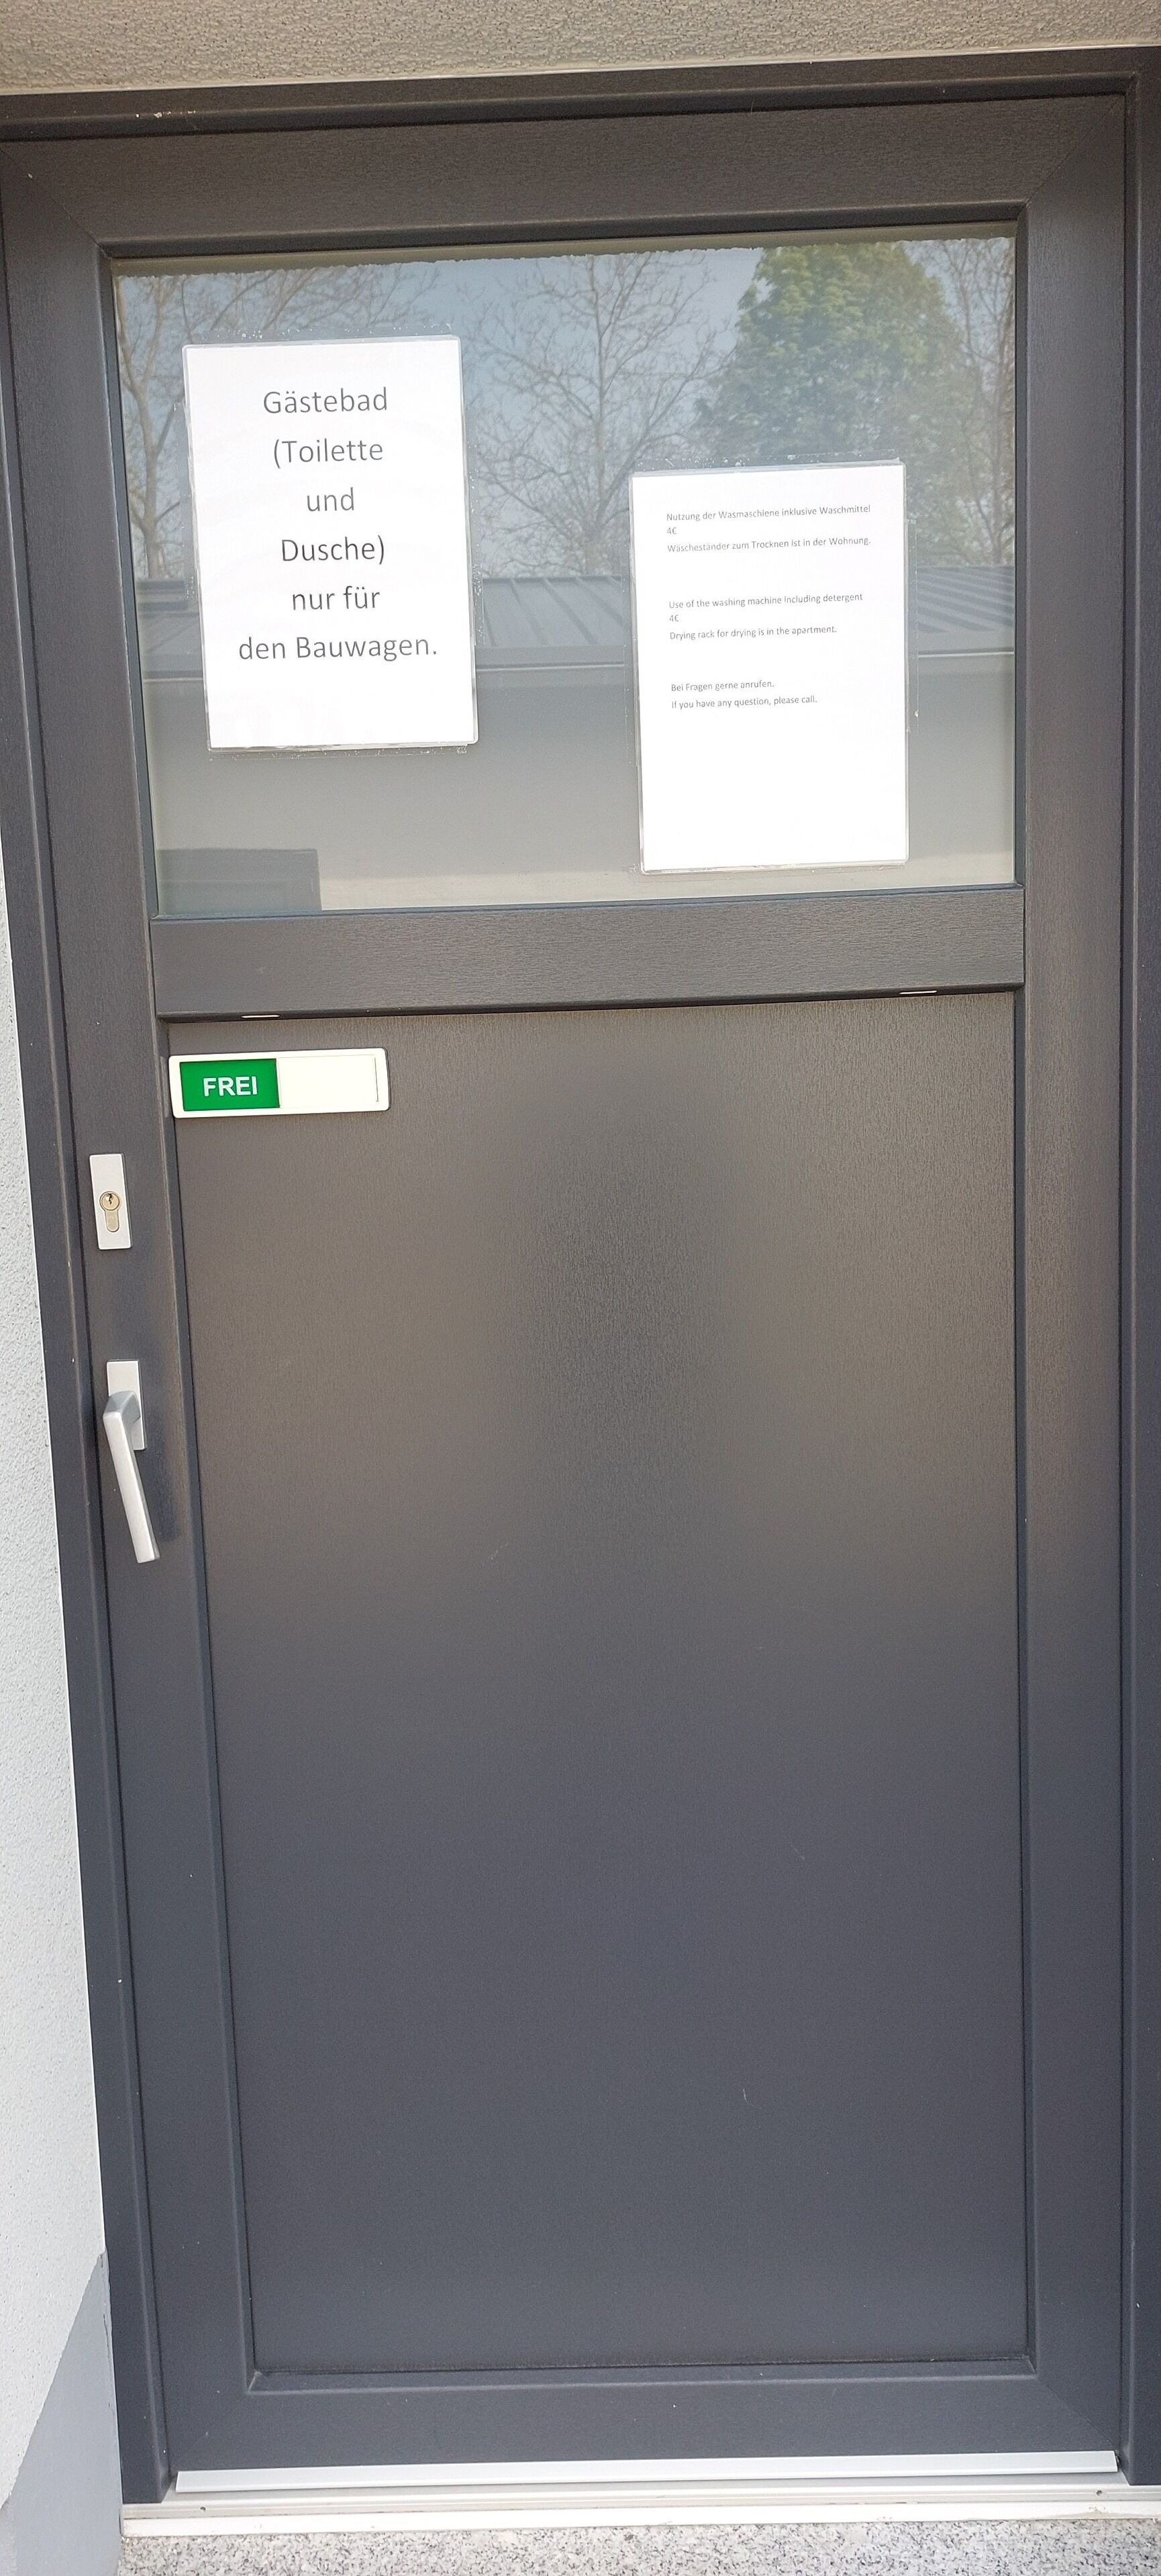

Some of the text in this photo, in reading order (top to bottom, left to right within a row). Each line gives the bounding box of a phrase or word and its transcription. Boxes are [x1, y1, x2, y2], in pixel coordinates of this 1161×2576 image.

[263, 386, 387, 414] Gästebad
[274, 437, 383, 469] (Toilette
[307, 486, 354, 512] und
[666, 504, 870, 522] Nutzung der Wasmaschiene inklusive Waschmittel
[666, 527, 677, 535] 4€
[281, 535, 385, 565] Dusche)
[667, 542, 730, 553] Wäscheständer
[751, 539, 789, 549] Trocknen
[803, 538, 811, 547] in
[813, 537, 827, 546] der
[828, 536, 871, 546] Wohnung.
[292, 585, 381, 610] nur für
[669, 600, 684, 609] Use
[685, 599, 695, 608] of
[696, 599, 710, 608] the
[711, 598, 746, 608] washing
[748, 596, 782, 606] machine
[823, 593, 864, 603] detergent
[669, 614, 680, 623] 4€
[670, 625, 838, 641] Drying rack for drying is in the apartment.
[239, 636, 437, 662] den Bauwagen.
[671, 679, 774, 692] Bei Fragen gerne anrufen.
[672, 694, 817, 710] If you have any question, please call.
[203, 1076, 258, 1097] FREI
